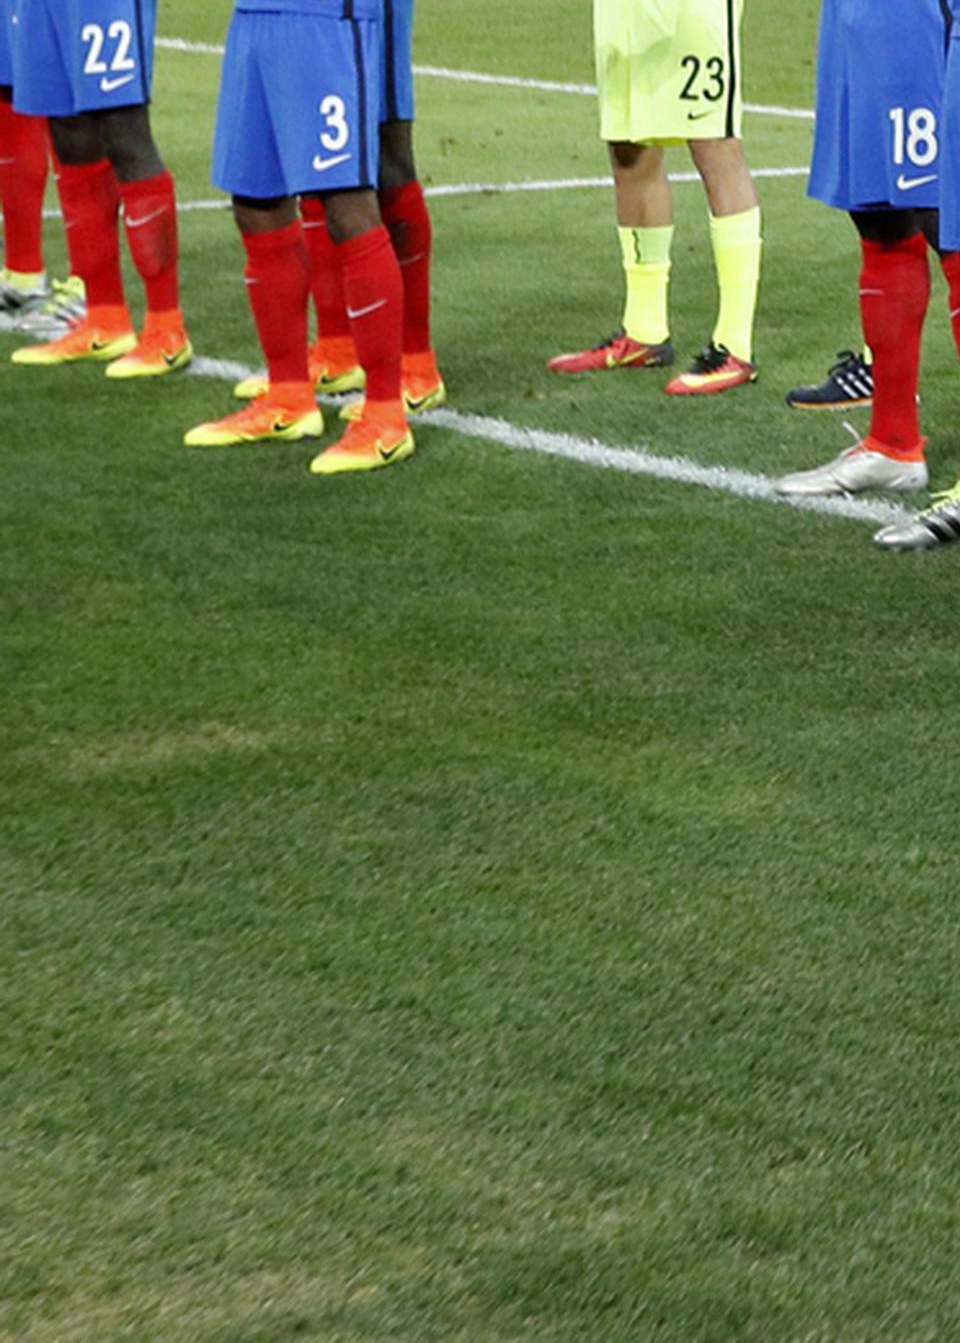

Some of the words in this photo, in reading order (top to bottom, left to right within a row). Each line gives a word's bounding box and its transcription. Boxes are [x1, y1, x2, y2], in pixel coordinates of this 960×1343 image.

[82, 20, 135, 74] 22
[679, 54, 725, 102] 23
[320, 94, 349, 152] 3
[889, 107, 938, 166] 18
